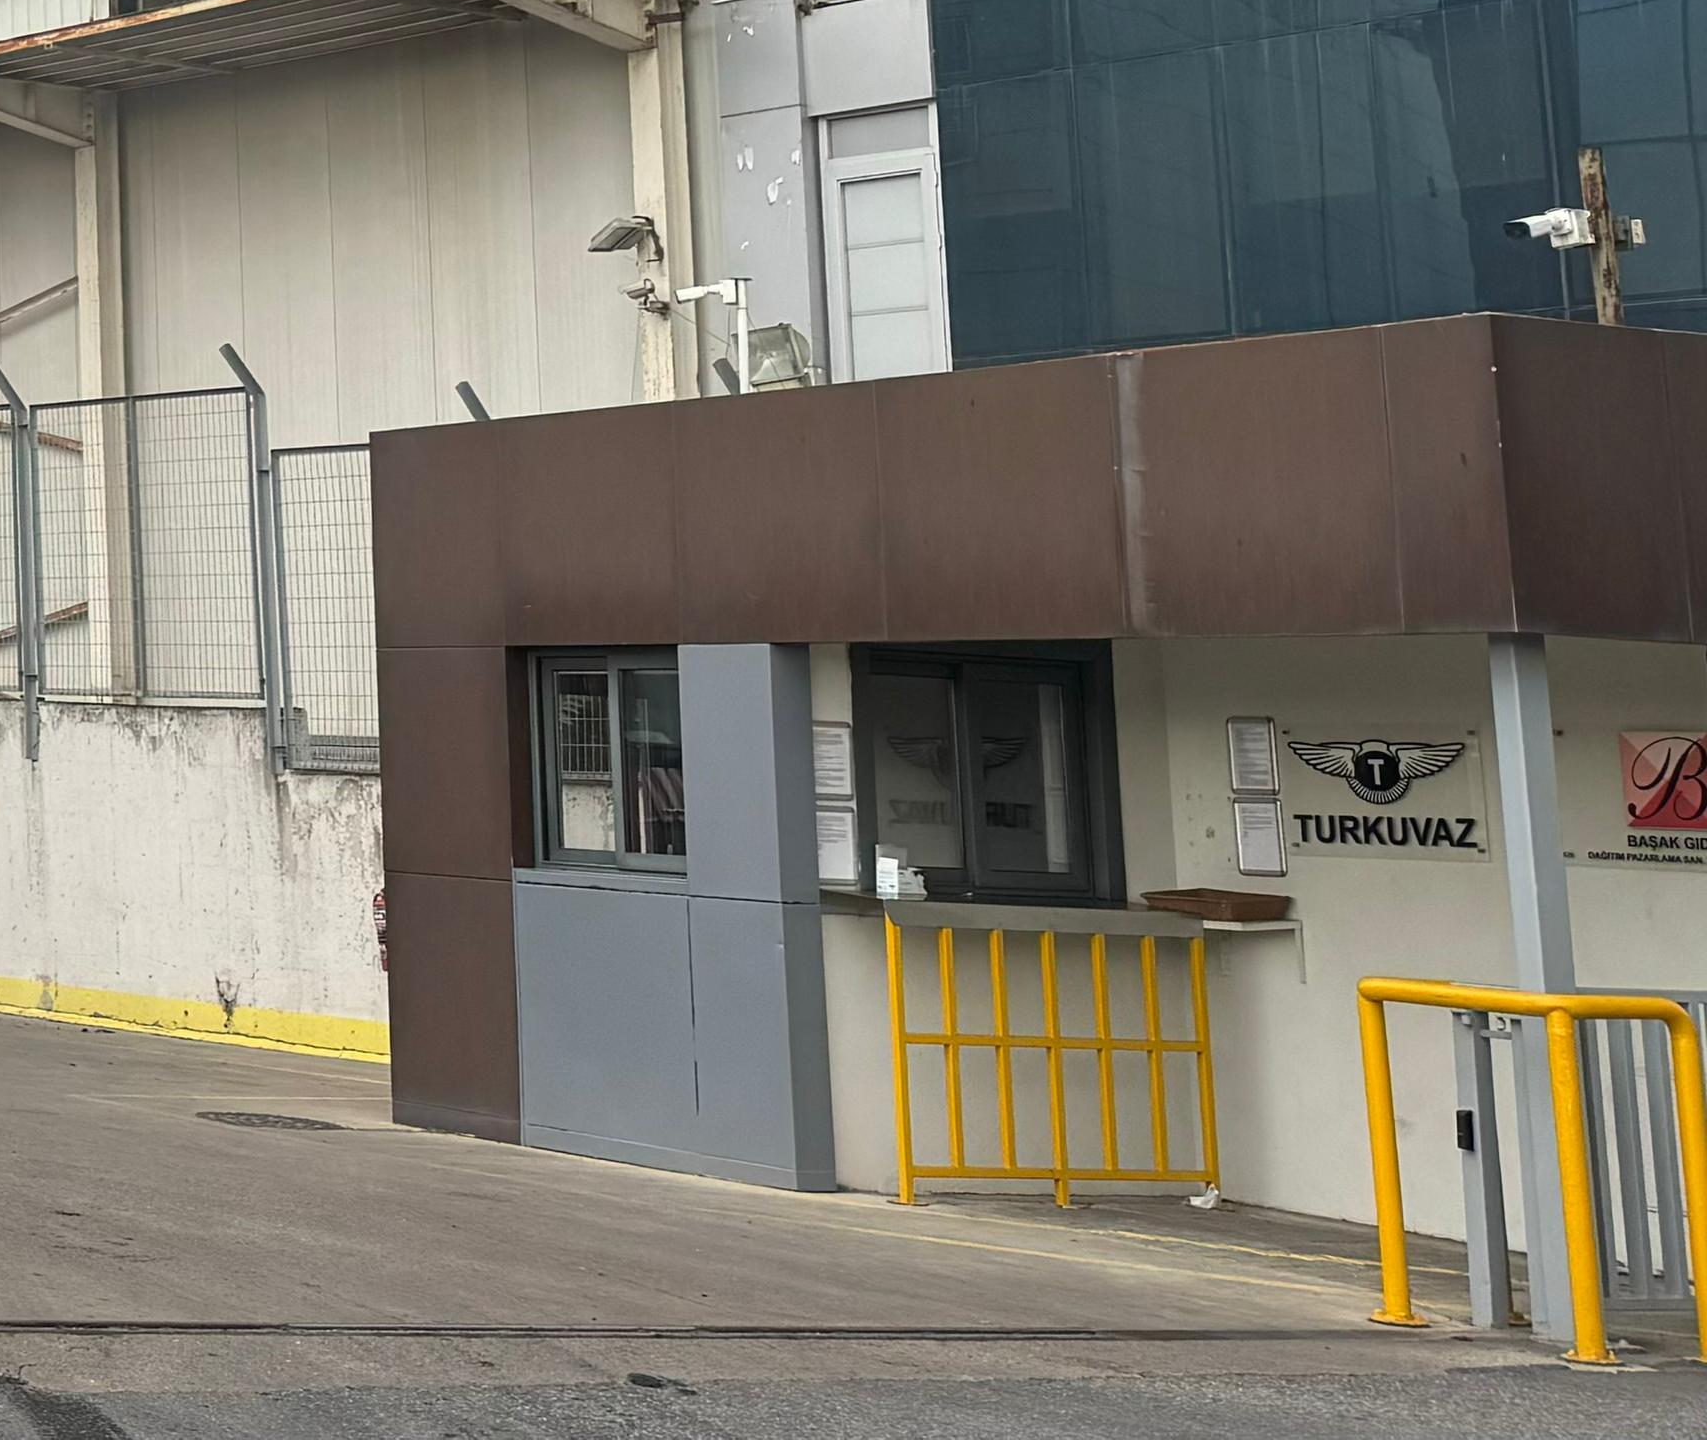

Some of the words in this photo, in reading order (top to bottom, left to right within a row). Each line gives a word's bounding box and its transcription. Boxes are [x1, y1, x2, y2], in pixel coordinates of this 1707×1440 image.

[1368, 759, 1384, 786] T
[1293, 814, 1478, 848] TURKUVAZ
[1627, 835, 1681, 851] BAŞAK
